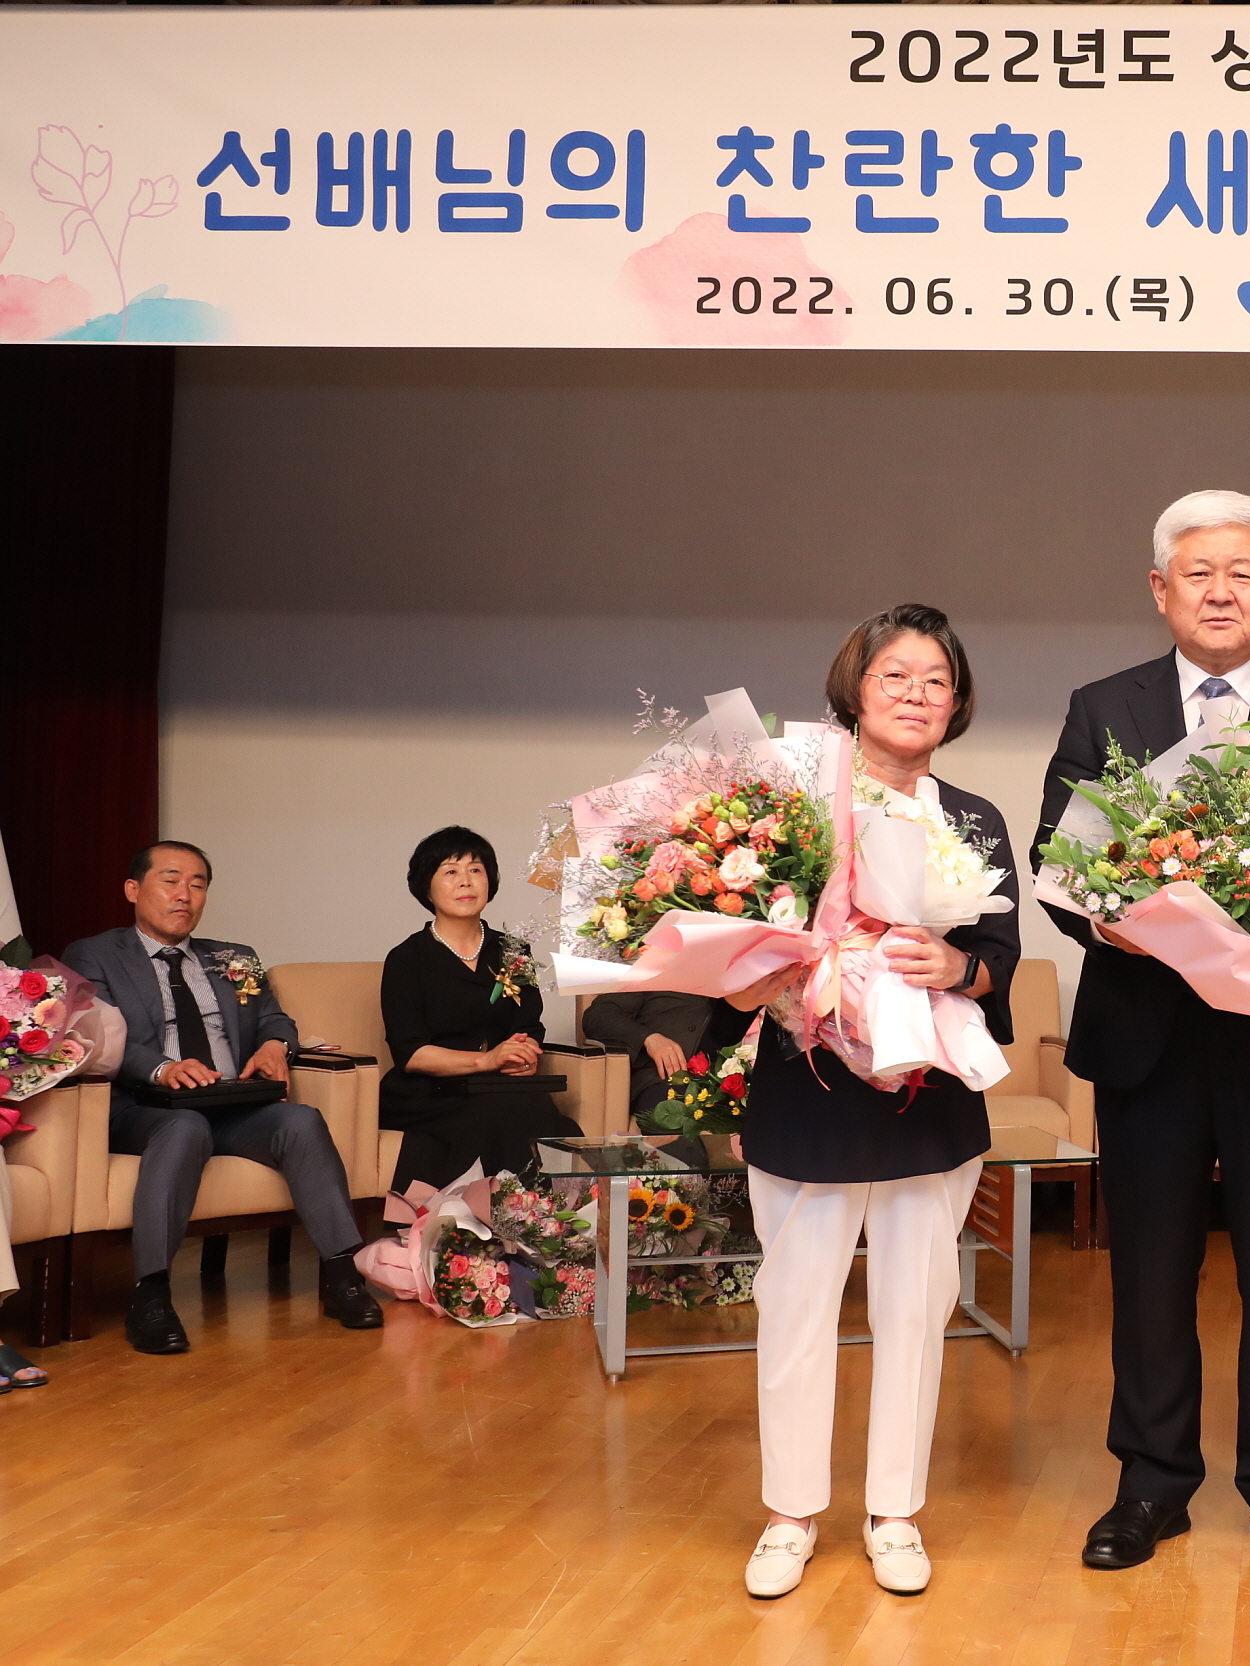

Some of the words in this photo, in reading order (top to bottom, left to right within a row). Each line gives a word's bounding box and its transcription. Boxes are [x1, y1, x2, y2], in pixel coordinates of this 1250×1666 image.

[849, 28, 1175, 89] 2022년도
[196, 127, 646, 233] 선배님의
[716, 123, 1083, 234] 찬란한
[1146, 128, 1249, 236] 새
[696, 276, 854, 315] 2022.
[884, 276, 974, 316] 06.
[1004, 275, 1195, 323] 30.(목)
